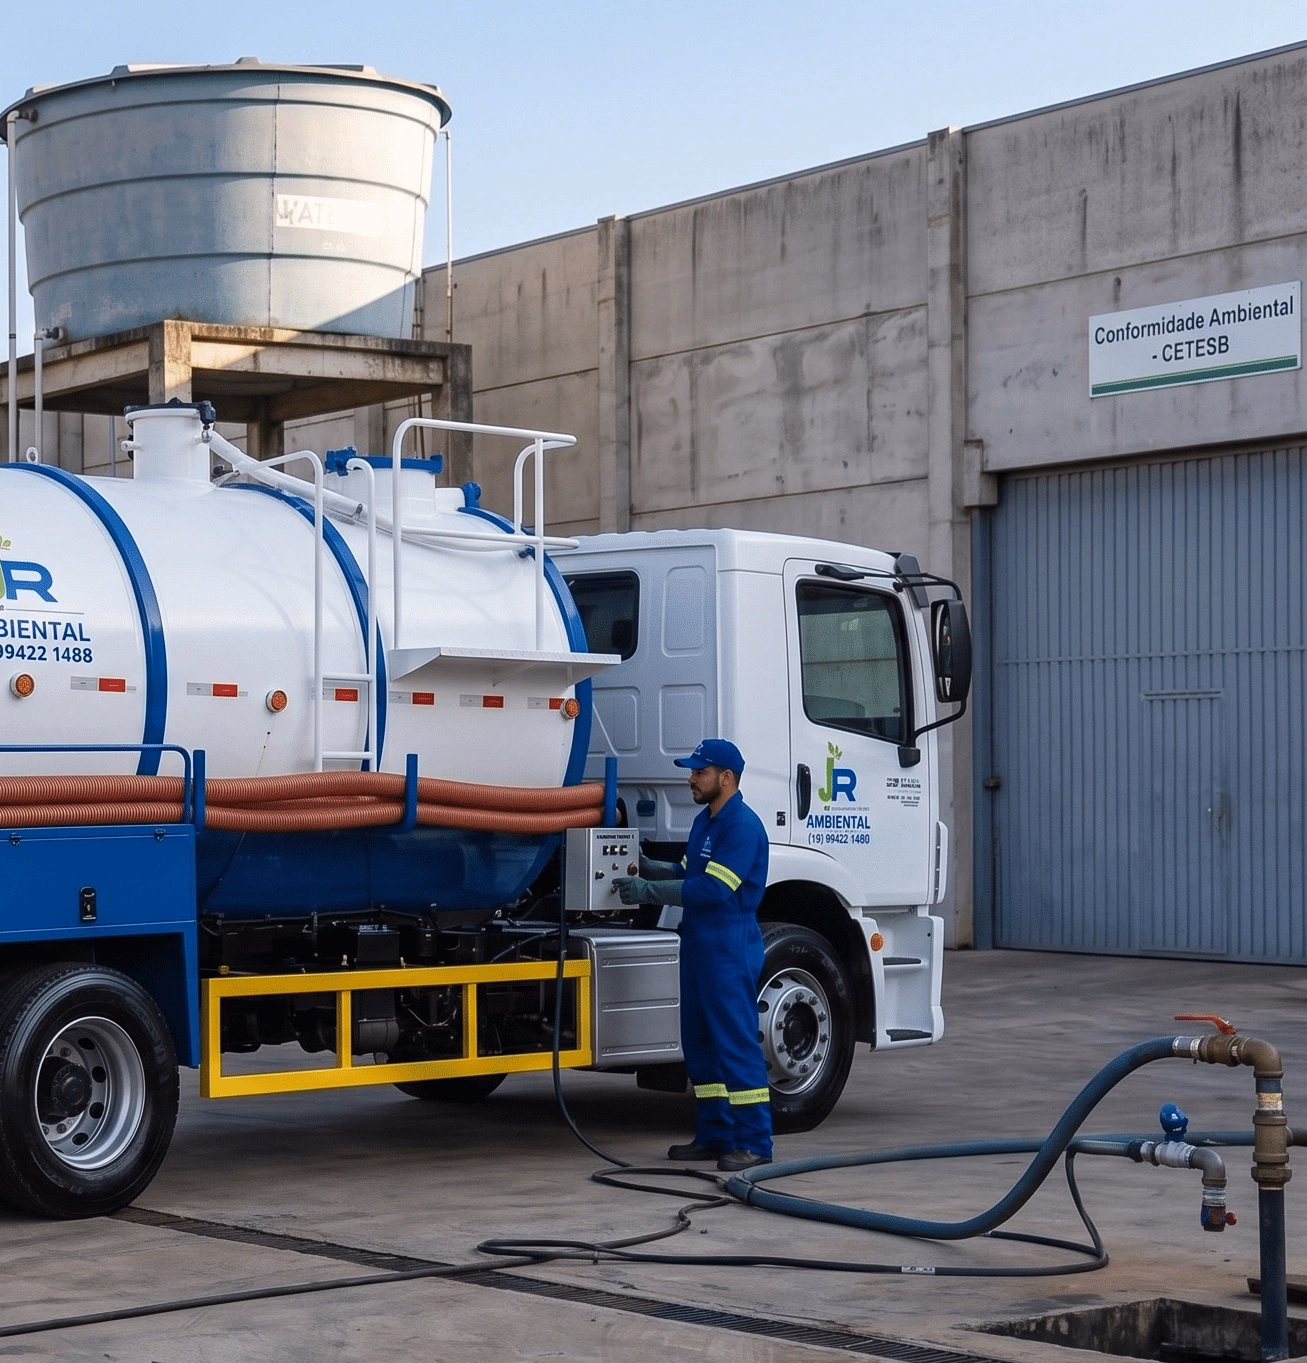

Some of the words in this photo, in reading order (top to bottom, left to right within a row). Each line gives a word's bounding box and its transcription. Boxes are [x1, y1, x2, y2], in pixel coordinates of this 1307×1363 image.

[1094, 312, 1205, 345] Conformidade
[1209, 295, 1294, 328] Ambiental
[1162, 335, 1230, 362] CETESB
[52, 646, 93, 663] 1488
[818, 757, 857, 802] JR
[806, 814, 871, 829] AMBIENTAL
[808, 833, 824, 845] (19)
